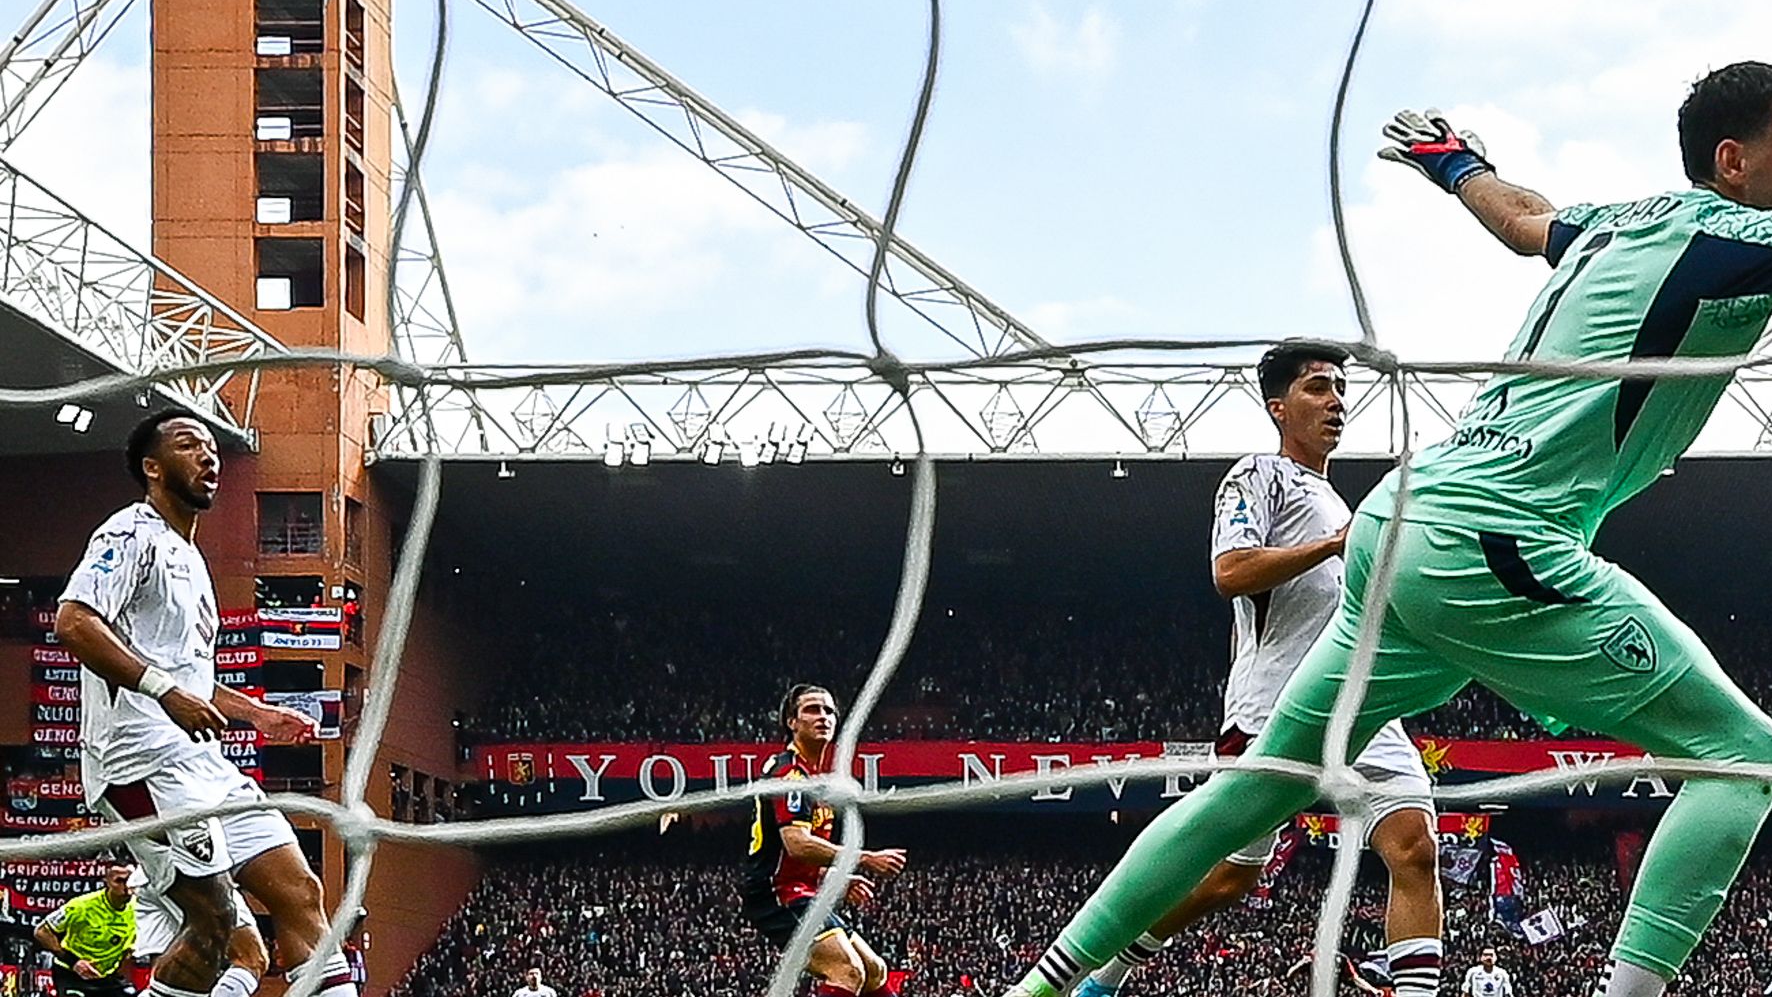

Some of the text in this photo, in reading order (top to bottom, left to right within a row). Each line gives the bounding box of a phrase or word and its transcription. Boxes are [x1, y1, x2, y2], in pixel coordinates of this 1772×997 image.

[216, 651, 257, 664] CLUB
[48, 686, 80, 701] GENO
[39, 782, 84, 796] GENO
[7, 863, 64, 877] GRIFONI
[32, 880, 91, 893] ANDREA
[26, 896, 66, 910] GENO
